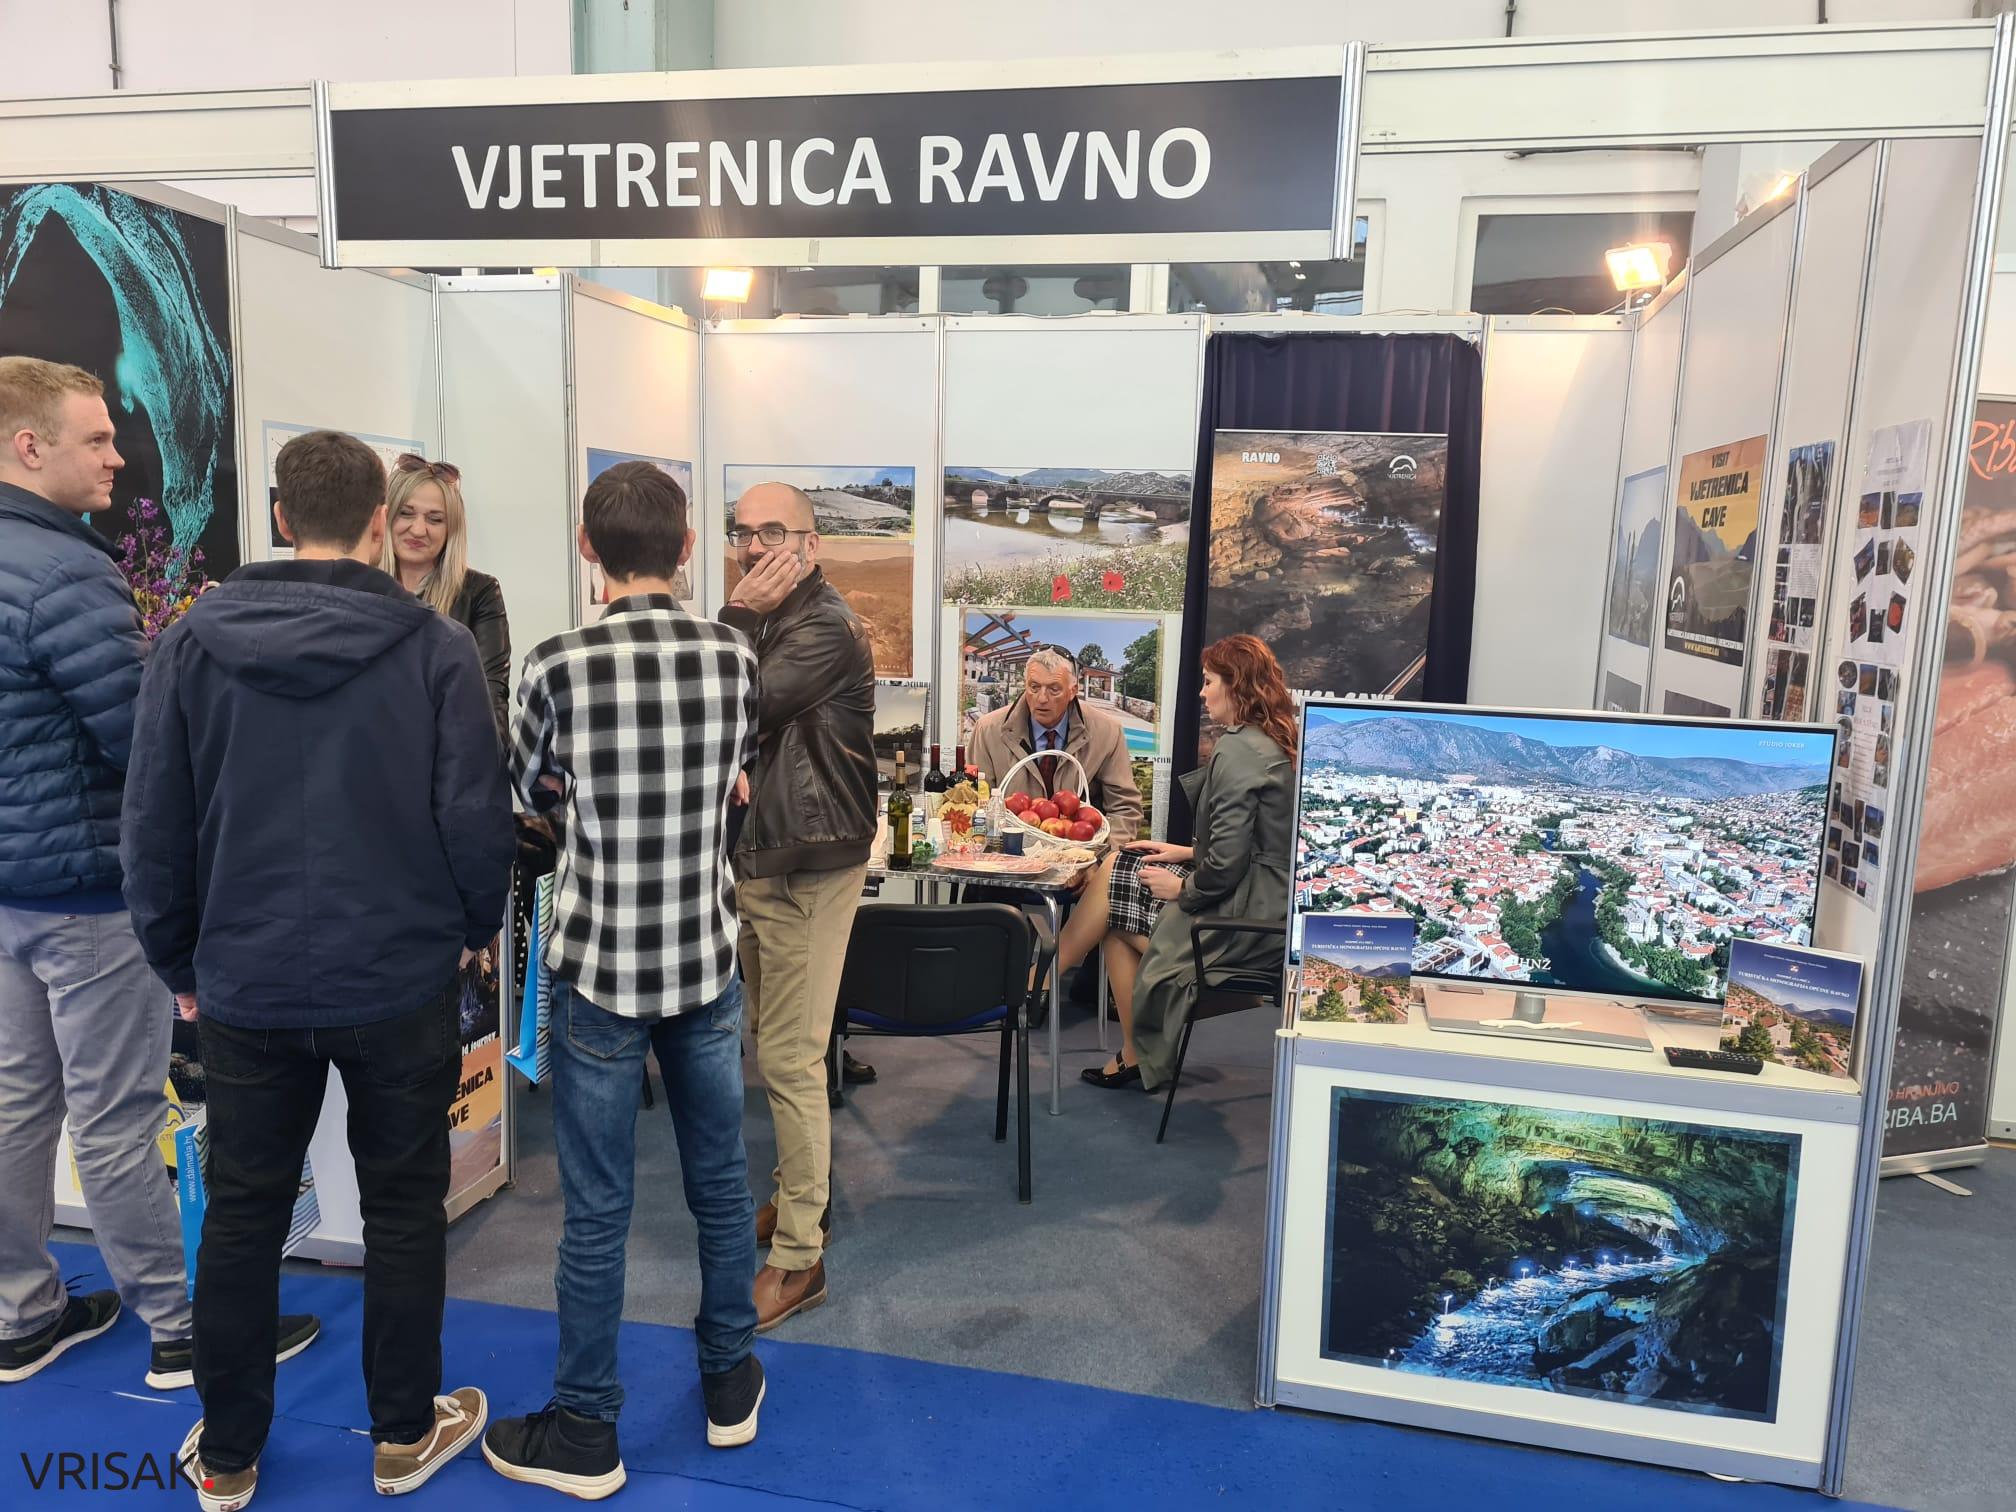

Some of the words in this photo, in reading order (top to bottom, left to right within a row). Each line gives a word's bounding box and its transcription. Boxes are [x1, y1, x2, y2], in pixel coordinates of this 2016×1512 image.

[451, 136, 892, 210] VJETRENICA
[919, 127, 1211, 203] RAVNO
[1241, 452, 1281, 464] RAVNO
[1711, 451, 1730, 469] VISIT
[1968, 418, 2016, 480] Rib
[1689, 471, 1749, 501] VJETRENICA
[1701, 506, 1727, 528] CAVE
[1519, 957, 1552, 970] HNŽ
[455, 1066, 494, 1101] ENICA
[183, 1135, 198, 1203] www.dalmatia.hr
